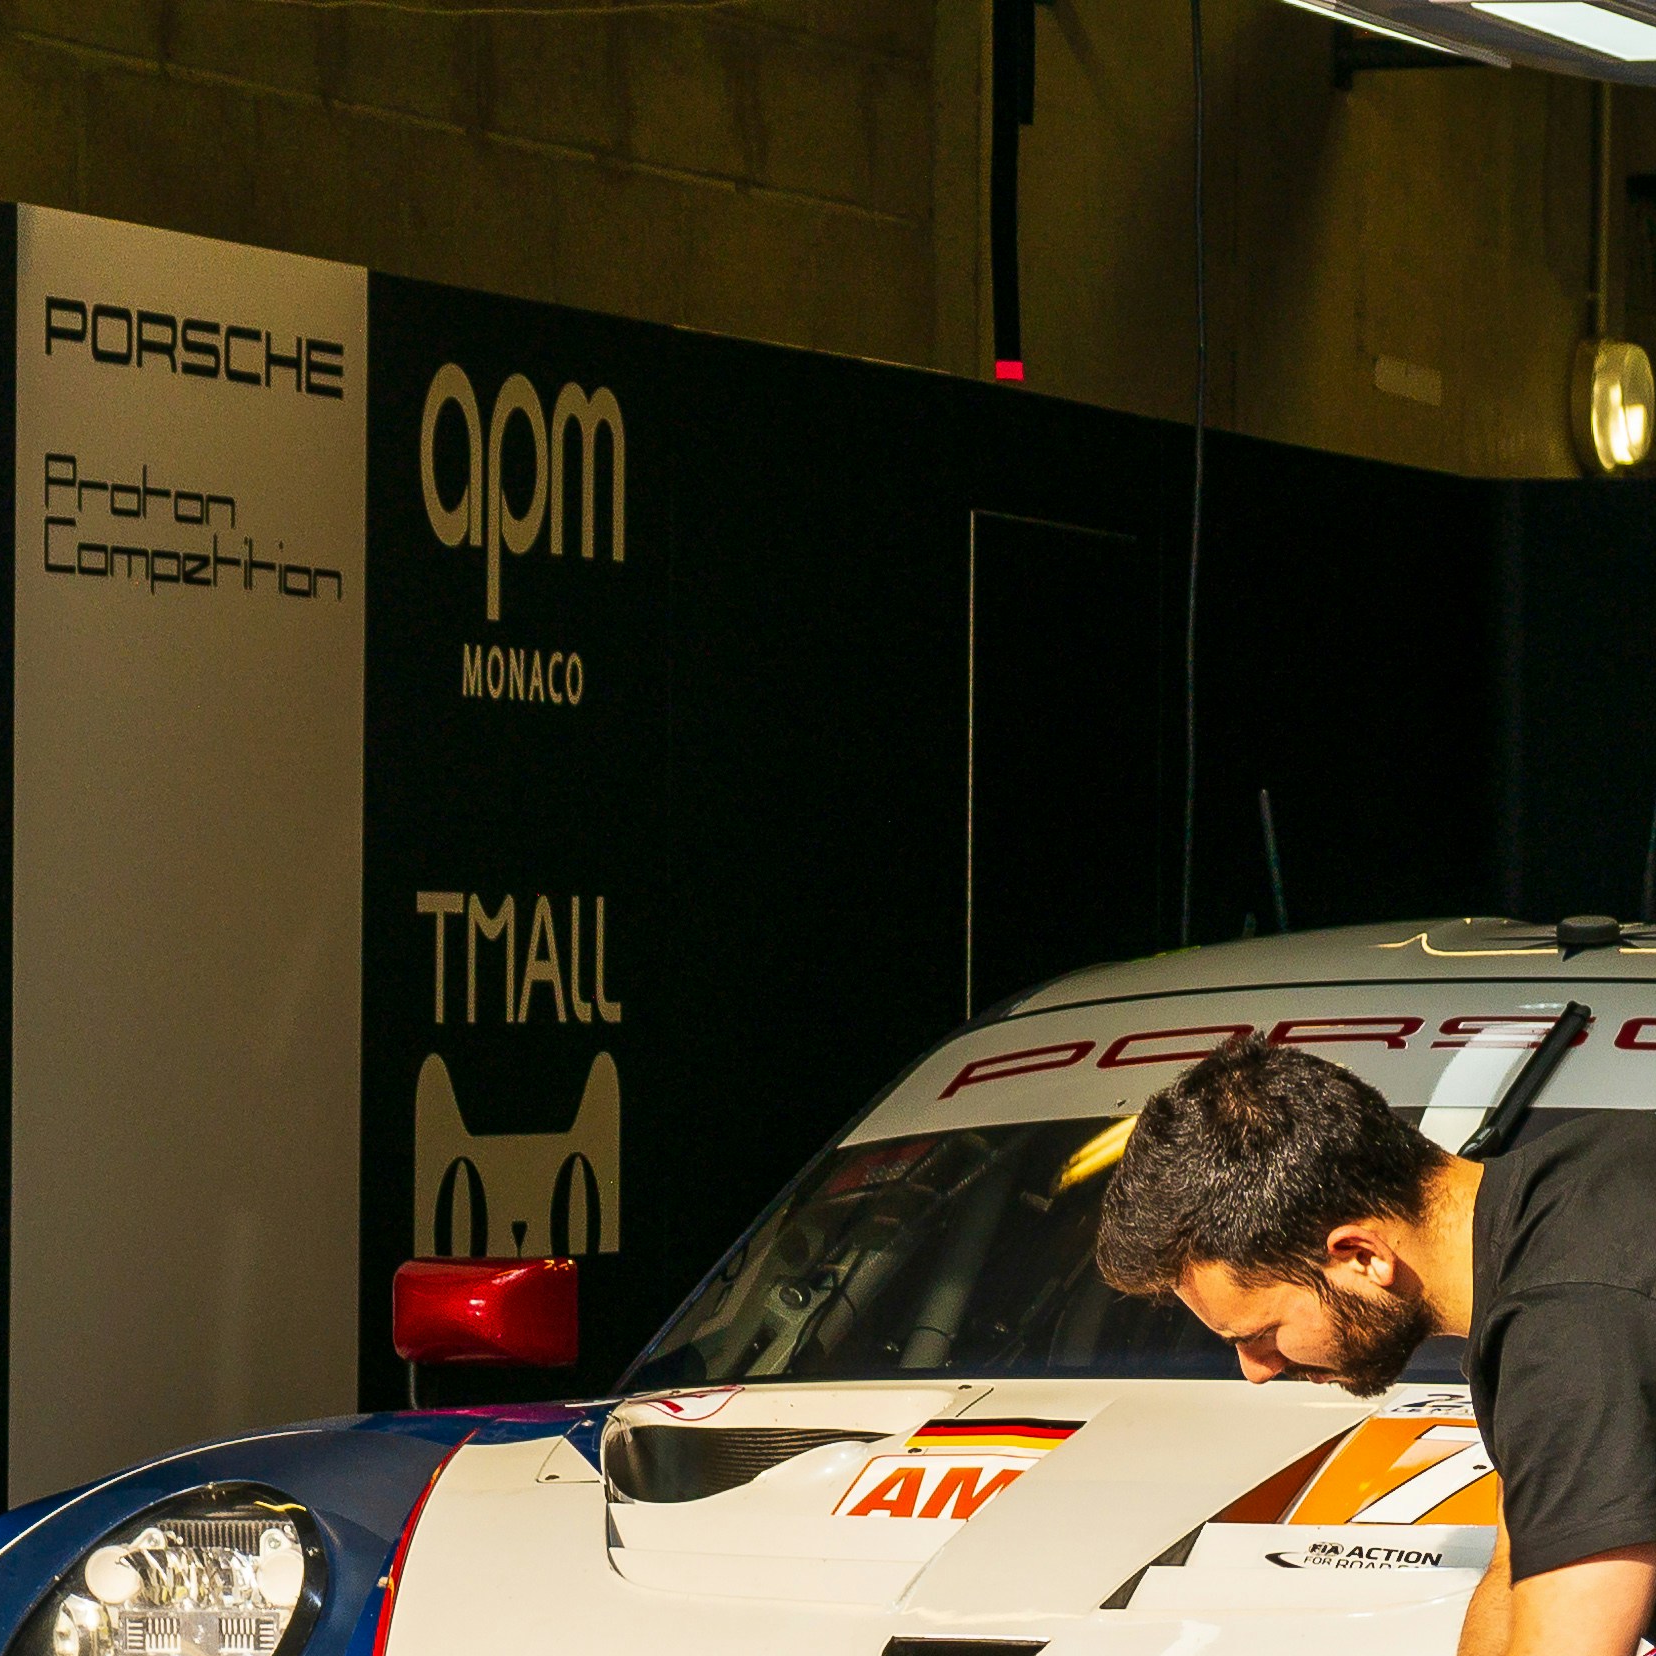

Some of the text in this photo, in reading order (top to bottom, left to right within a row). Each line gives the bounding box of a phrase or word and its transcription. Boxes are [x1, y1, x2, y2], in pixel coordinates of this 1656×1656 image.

[45, 295, 344, 399] PORSCHE
[45, 452, 235, 529] Proton
[420, 362, 625, 621] apm
[44, 515, 342, 601] Competition
[462, 643, 583, 706] MONACO
[416, 891, 622, 1024] TMALL
[846, 1466, 1027, 1520] AM
[1346, 1545, 1443, 1568] ACTION
